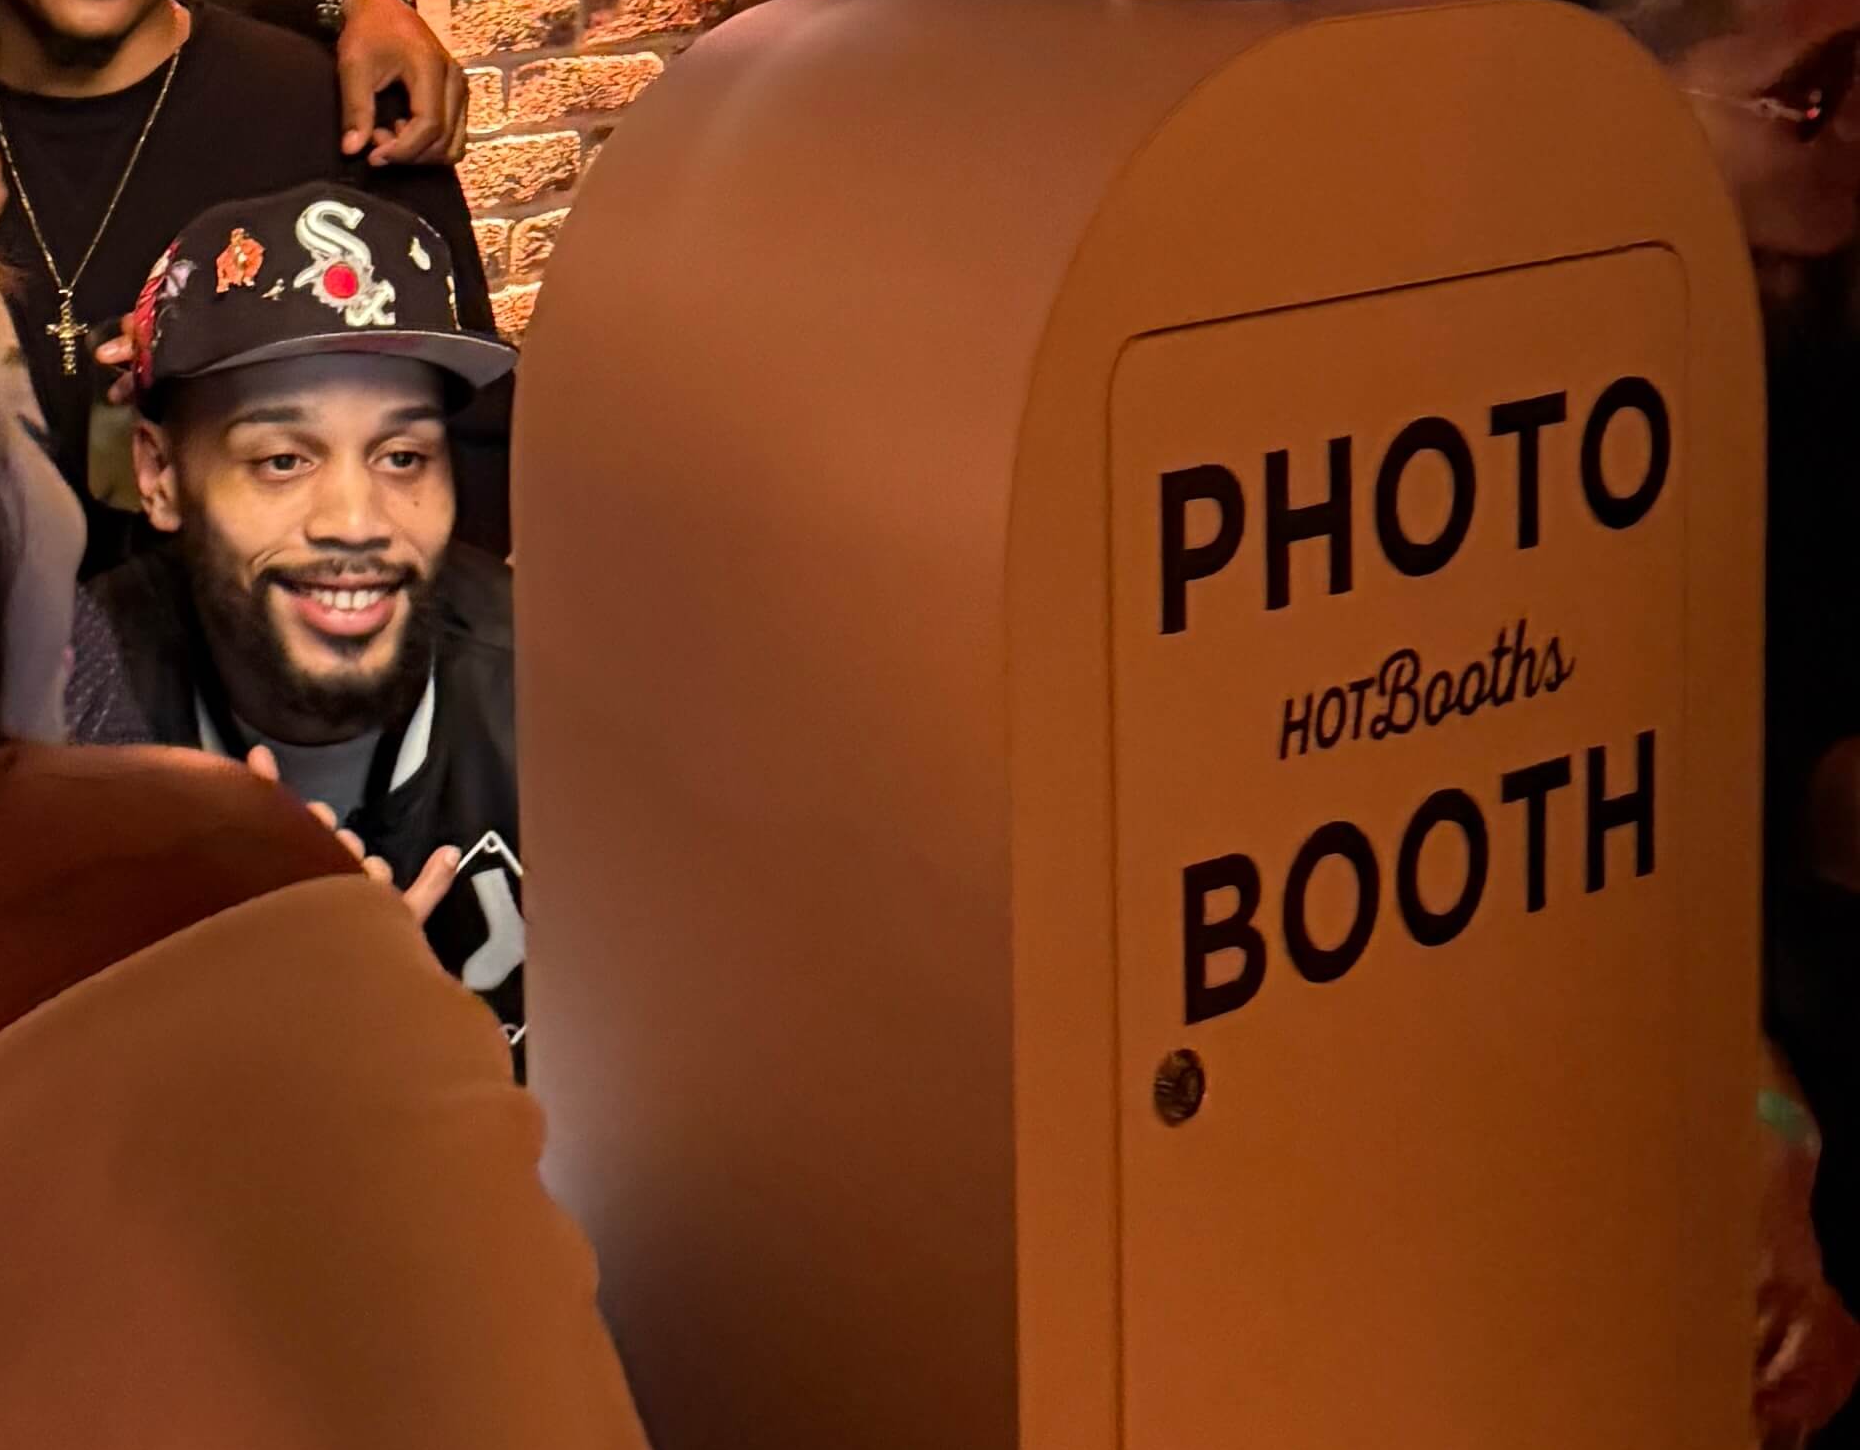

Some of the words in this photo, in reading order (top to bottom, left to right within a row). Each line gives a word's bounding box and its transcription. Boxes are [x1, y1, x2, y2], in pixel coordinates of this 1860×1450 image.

[1159, 375, 1671, 635] PHOTO
[1278, 618, 1576, 761] HOTBooths
[1182, 728, 1657, 1026] BOOTH
